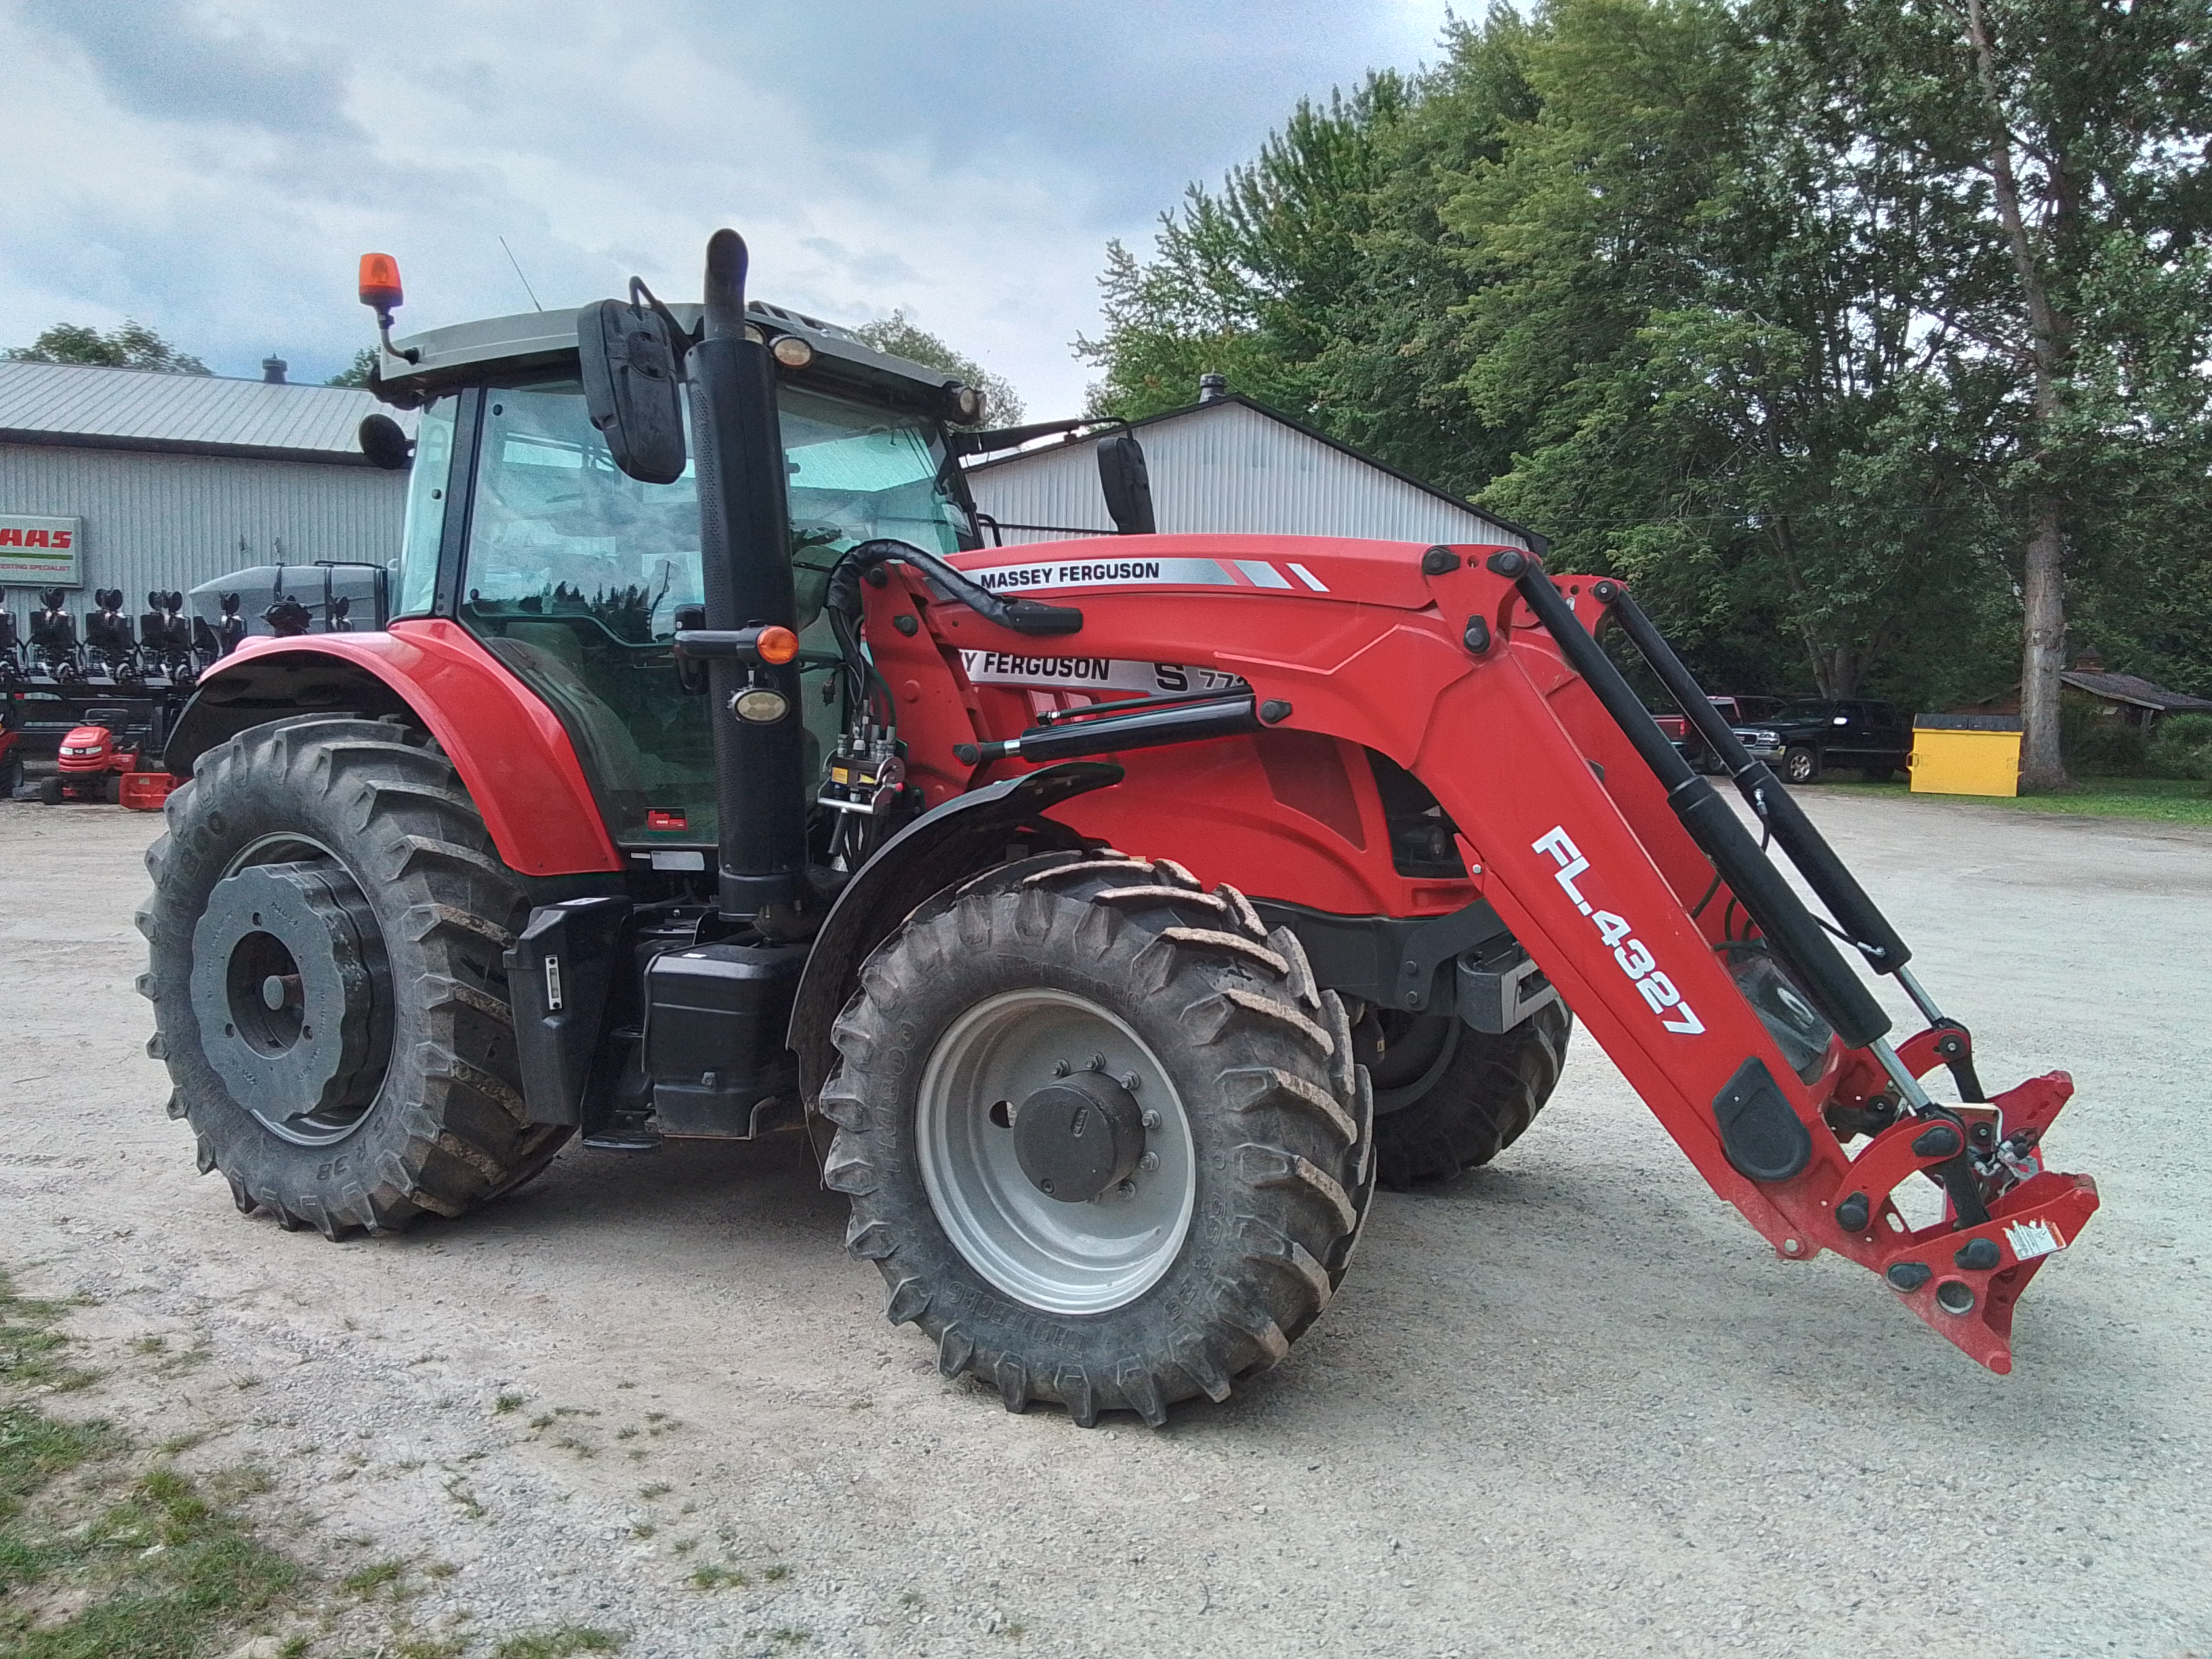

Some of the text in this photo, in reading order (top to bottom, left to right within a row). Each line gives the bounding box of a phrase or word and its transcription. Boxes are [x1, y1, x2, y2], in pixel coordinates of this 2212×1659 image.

[981, 562, 1160, 588] MASSEY FERGUSON
[983, 653, 1110, 680] FERGUSON
[1154, 662, 1188, 691] S
[1531, 825, 1706, 1035] FL.4327
[947, 1281, 1085, 1359] TRELLEBORG
